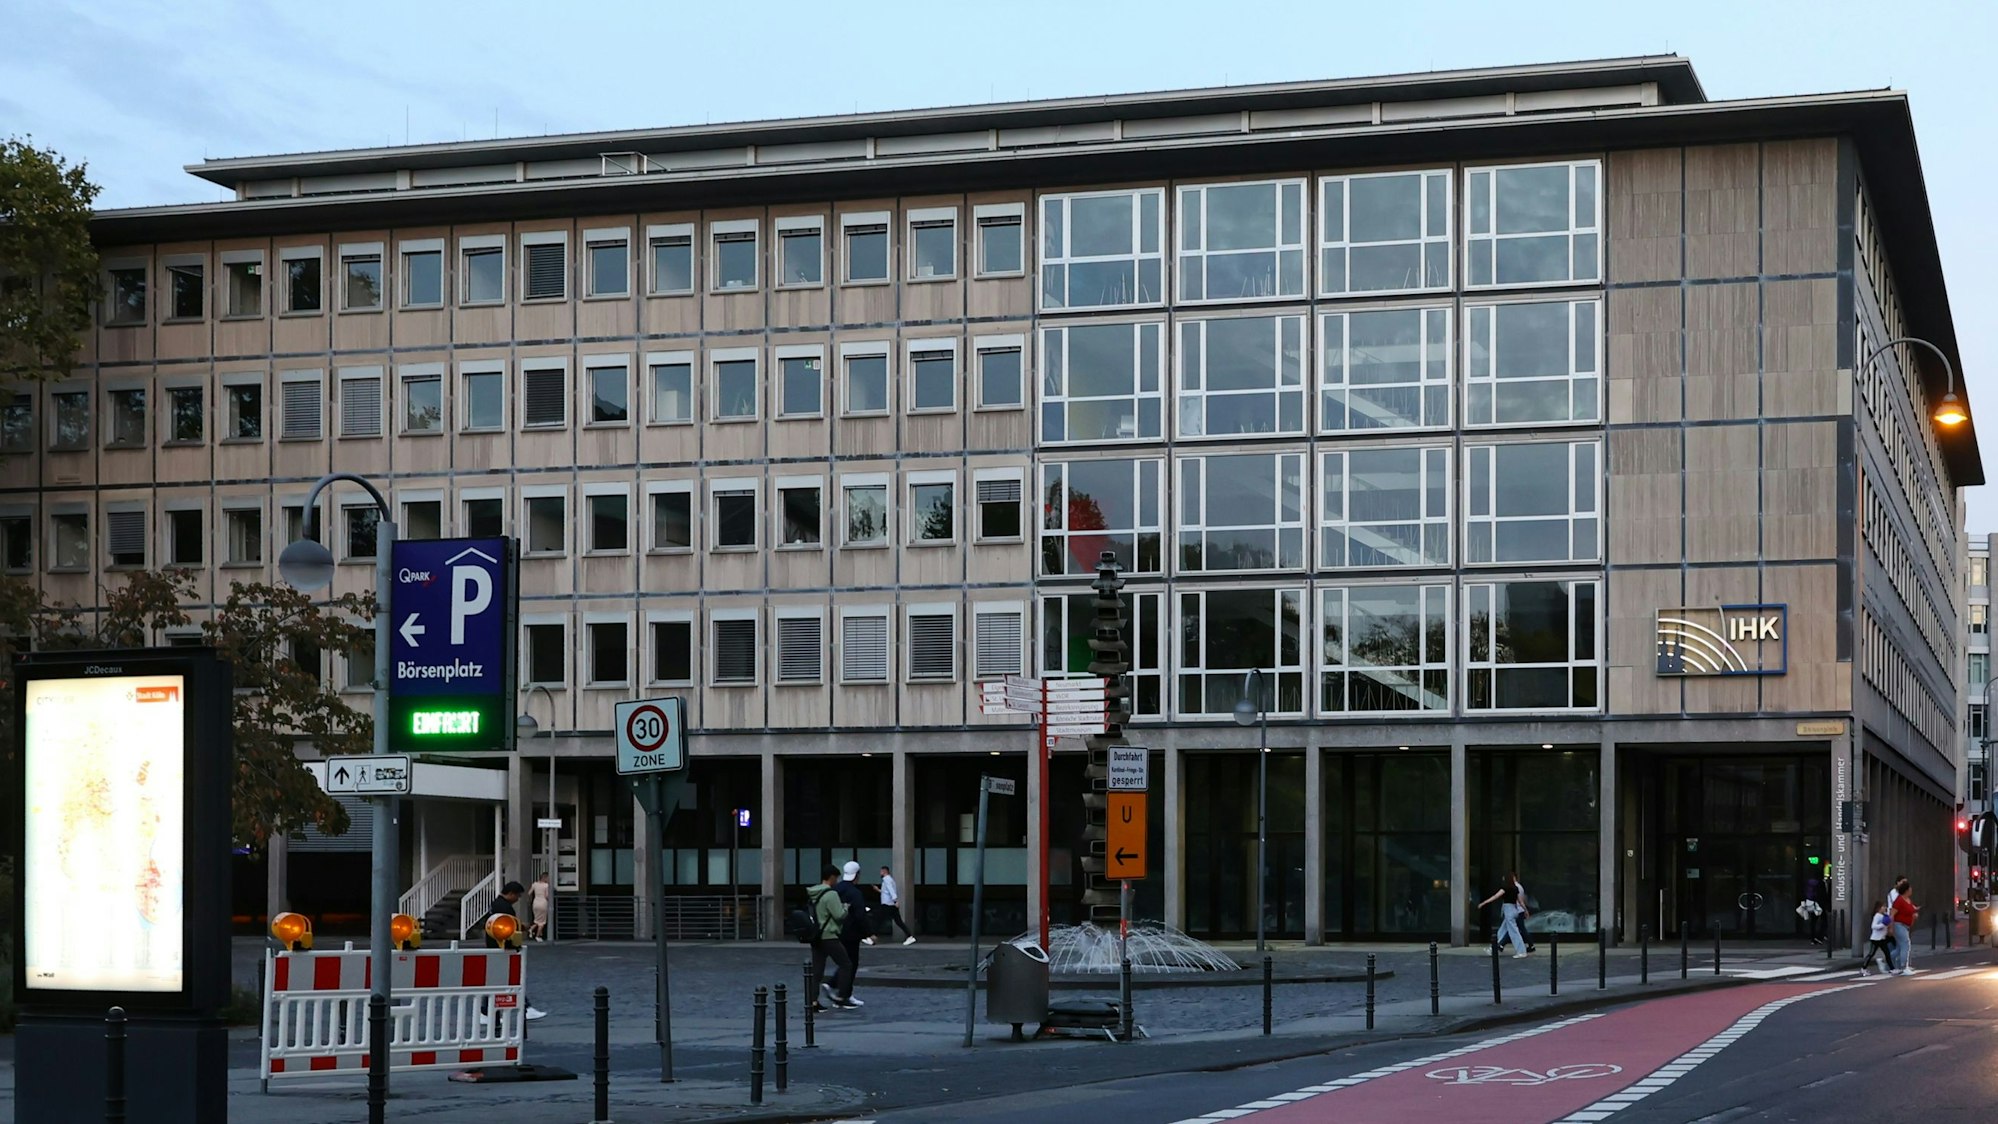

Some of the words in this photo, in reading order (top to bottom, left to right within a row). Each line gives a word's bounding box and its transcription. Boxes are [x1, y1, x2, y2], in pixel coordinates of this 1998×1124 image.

[450, 565, 493, 645] P
[1729, 616, 1780, 641] IHK
[84, 665, 123, 674] JCDecaux
[397, 657, 483, 683] Börsenplatz
[635, 717, 660, 740] 30
[633, 753, 666, 768] ZONE
[1113, 751, 1143, 761] Durchfahrt
[1111, 776, 1144, 787] gesperrt
[1122, 805, 1132, 823] U
[1836, 834, 1846, 852] und
[1836, 854, 1846, 901] Industrie-
